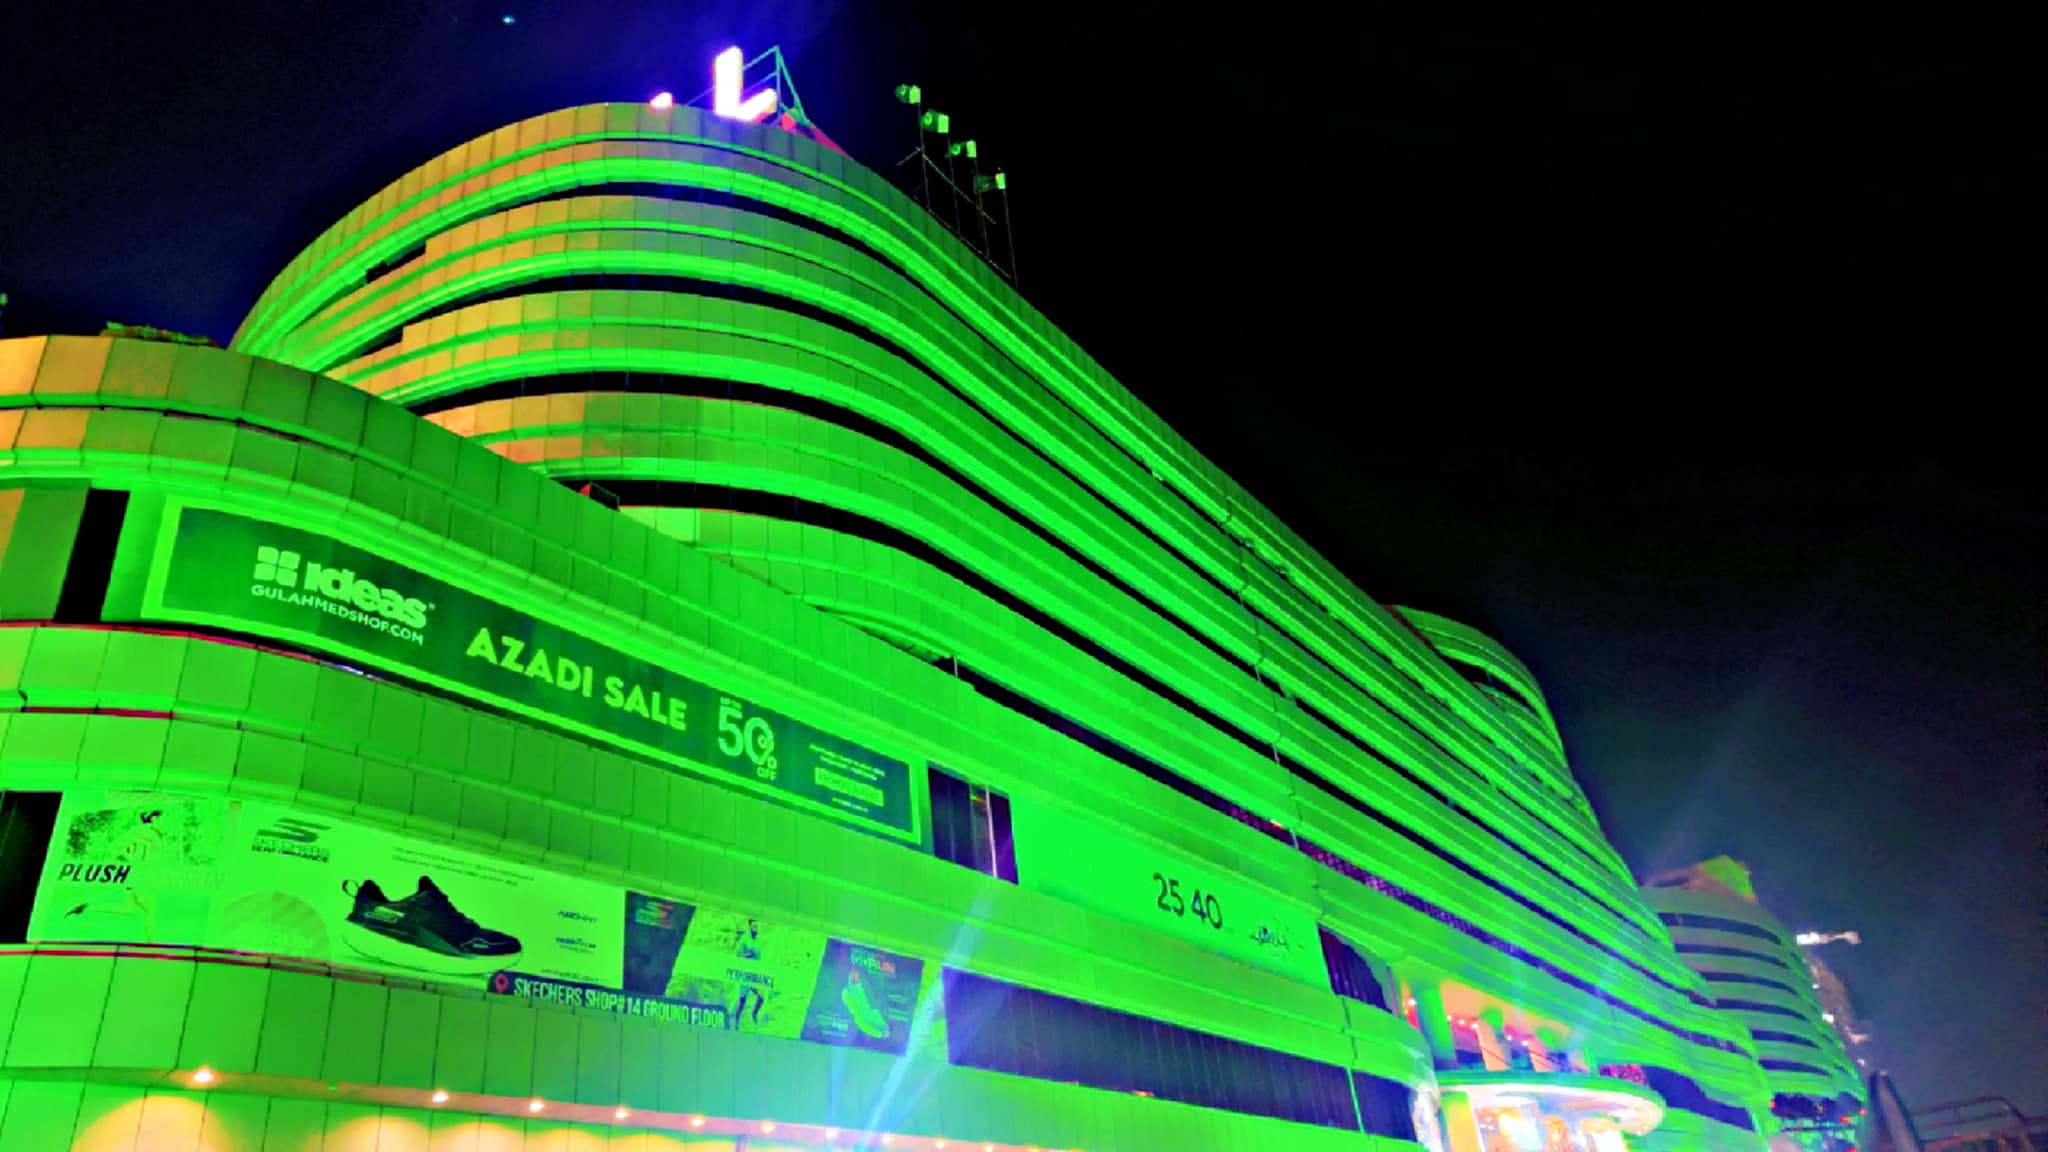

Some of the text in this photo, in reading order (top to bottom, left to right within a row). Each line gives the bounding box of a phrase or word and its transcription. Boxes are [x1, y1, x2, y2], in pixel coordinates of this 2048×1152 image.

[251, 584, 423, 646] GULAHMEDSHOP.COM
[466, 627, 687, 731] AZADI SALE
[57, 863, 131, 884] PLUSH
[514, 977, 582, 1007] SKECHERS
[644, 999, 690, 1025] GROUND
[691, 1009, 725, 1029] FLOOR
